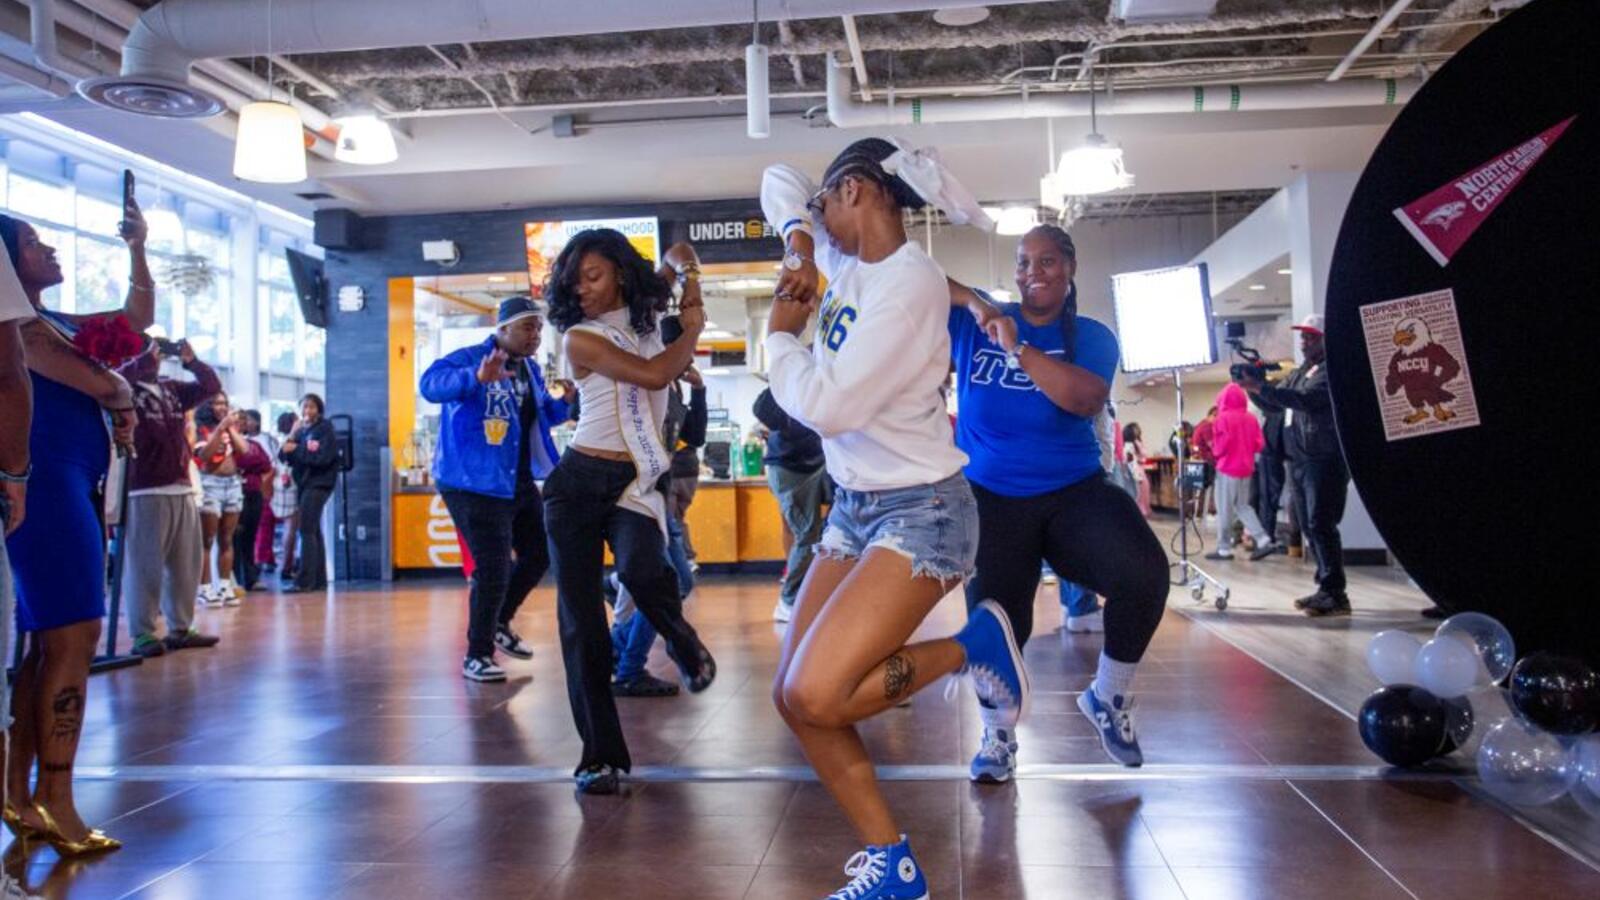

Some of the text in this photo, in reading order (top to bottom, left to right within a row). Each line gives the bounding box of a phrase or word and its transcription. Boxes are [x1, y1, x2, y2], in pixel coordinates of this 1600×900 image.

[1454, 159, 1507, 199] NORTH
[1471, 169, 1521, 212] CENTRAL
[689, 221, 745, 241] UNDER
[1362, 298, 1421, 317] SUPPORTING
[1404, 302, 1452, 317] VERSATILITY
[1397, 357, 1429, 373] NCCU
